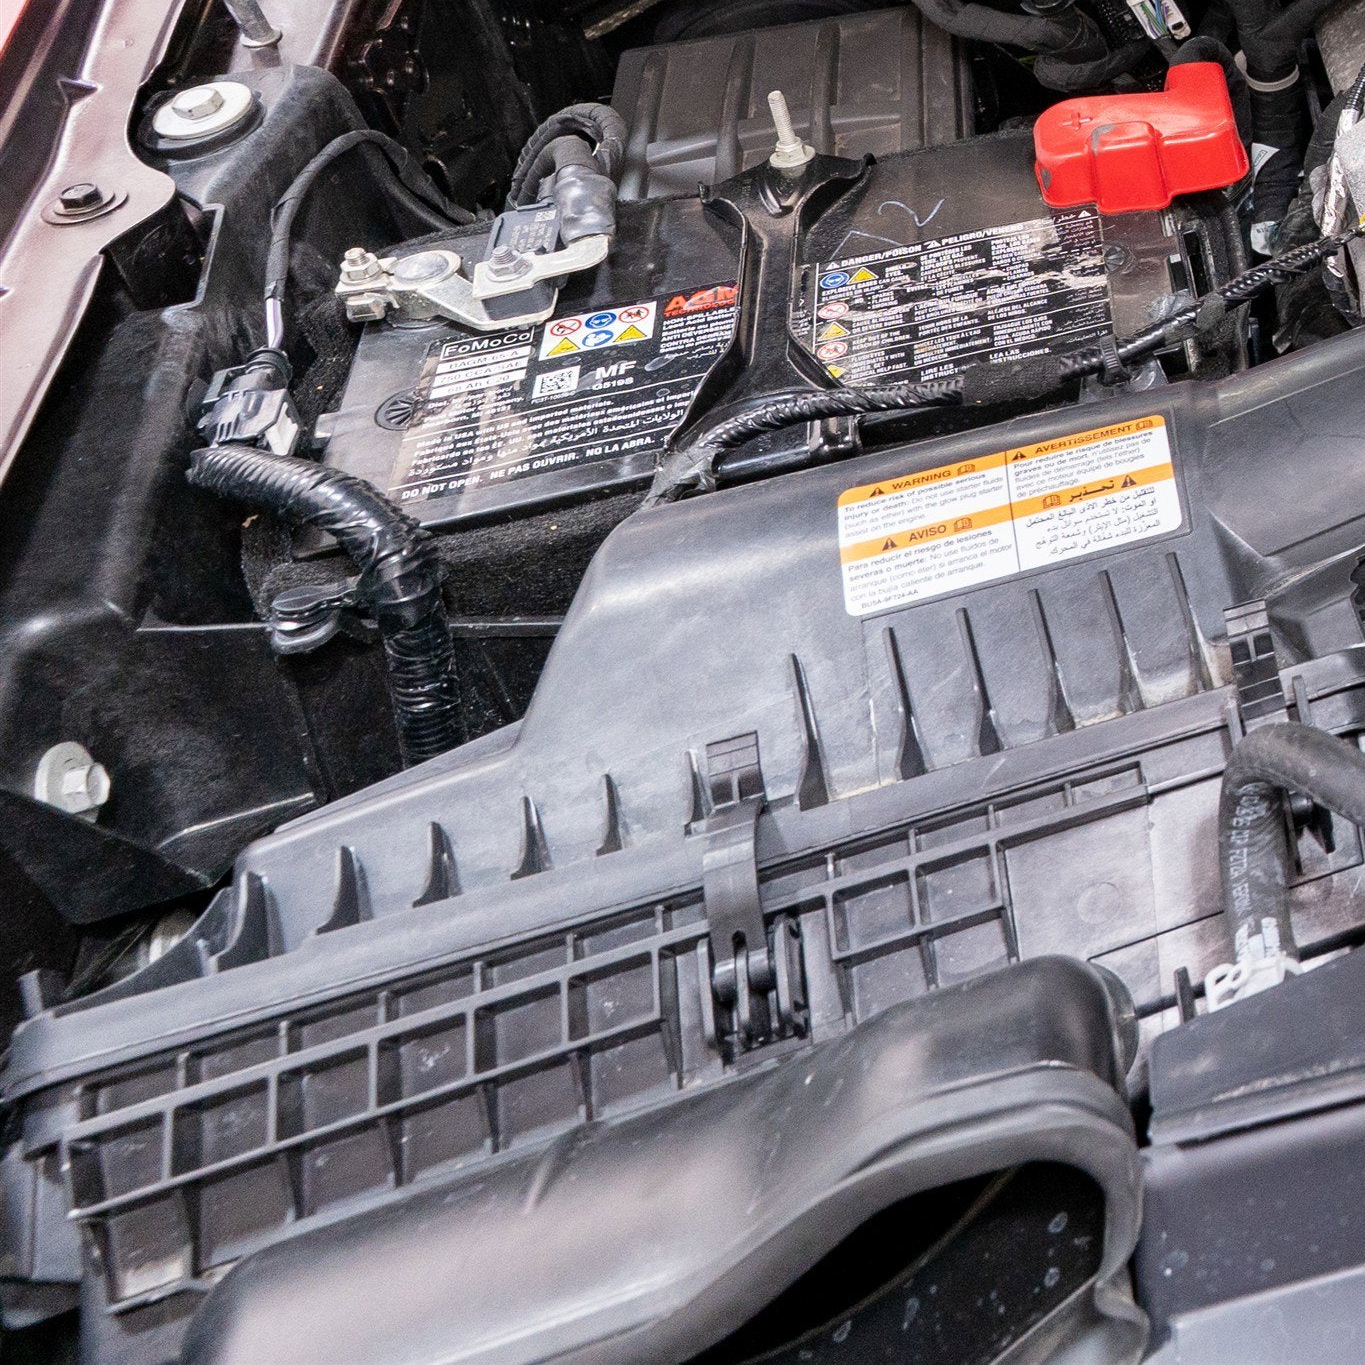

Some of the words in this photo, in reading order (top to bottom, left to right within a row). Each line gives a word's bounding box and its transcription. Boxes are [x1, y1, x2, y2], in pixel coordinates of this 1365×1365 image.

[840, 243, 922, 267] DANGER/POISON
[443, 329, 531, 357] FoMoCo
[594, 359, 636, 380] MF
[1013, 459, 1033, 469] Pour
[1074, 443, 1101, 454] risque
[1113, 430, 1153, 444] blessures
[1034, 424, 1132, 454] AVERTISSEMENT
[421, 481, 448, 496] NOT
[448, 473, 484, 489] OPEN.
[489, 468, 505, 480] NE
[507, 462, 531, 476] PAS
[532, 451, 579, 471] OUVRIR.
[585, 446, 602, 459] NO
[603, 442, 619, 455] LA
[620, 434, 655, 451] ABRA.
[1013, 465, 1042, 476] graves
[856, 497, 886, 509] reduce
[888, 493, 904, 501] risk
[917, 480, 953, 495] possible
[954, 472, 985, 485] serious
[891, 469, 951, 490] WARNING
[955, 481, 981, 492] starter
[982, 475, 1003, 486] fluids
[977, 484, 1003, 495] starter
[908, 524, 947, 542] AVISO
[869, 552, 901, 566] reducir
[913, 542, 942, 556] riesgo
[955, 529, 992, 544] lesiones
